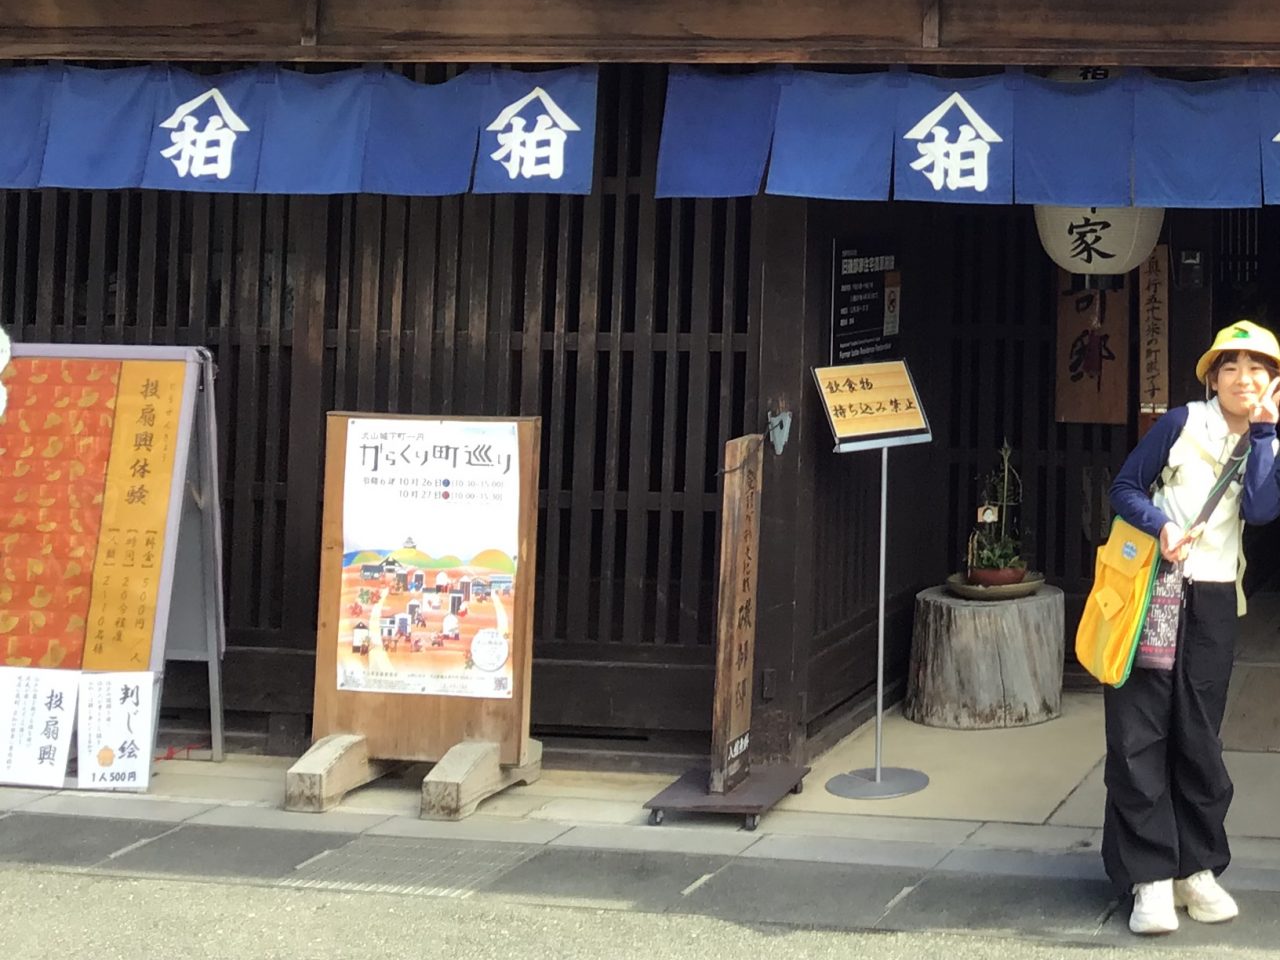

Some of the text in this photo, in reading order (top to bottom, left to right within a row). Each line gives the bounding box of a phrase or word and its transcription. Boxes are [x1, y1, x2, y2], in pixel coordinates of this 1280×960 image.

[161, 116, 238, 179] 柏
[490, 116, 567, 179] 柏
[911, 126, 991, 192] 柏
[1068, 217, 1116, 263] 家
[825, 377, 874, 394] 飲食物
[833, 398, 917, 419] 持ち込み禁止
[125, 378, 161, 506] 投扇興体験
[360, 443, 512, 475] からくり町巡り
[38, 689, 65, 767] 投扇興
[118, 684, 141, 759] 判じ絵
[91, 771, 137, 784] 1人500円
